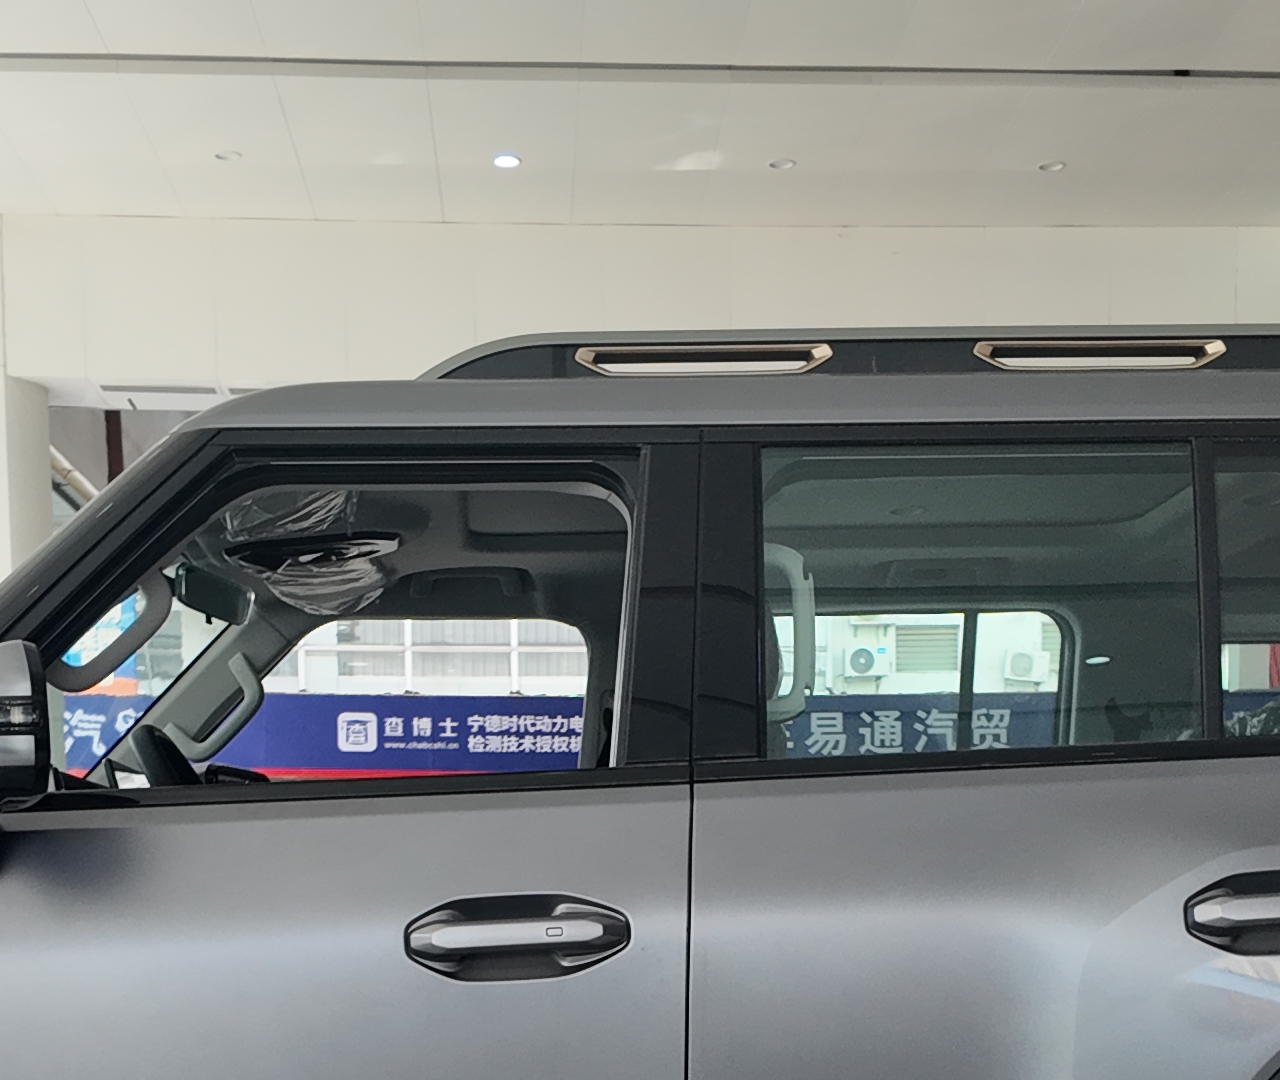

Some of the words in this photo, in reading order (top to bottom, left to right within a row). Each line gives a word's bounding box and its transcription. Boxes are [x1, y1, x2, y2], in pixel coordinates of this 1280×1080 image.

[383, 716, 459, 738] 查博士
[782, 708, 1011, 756] 易通汽贸
